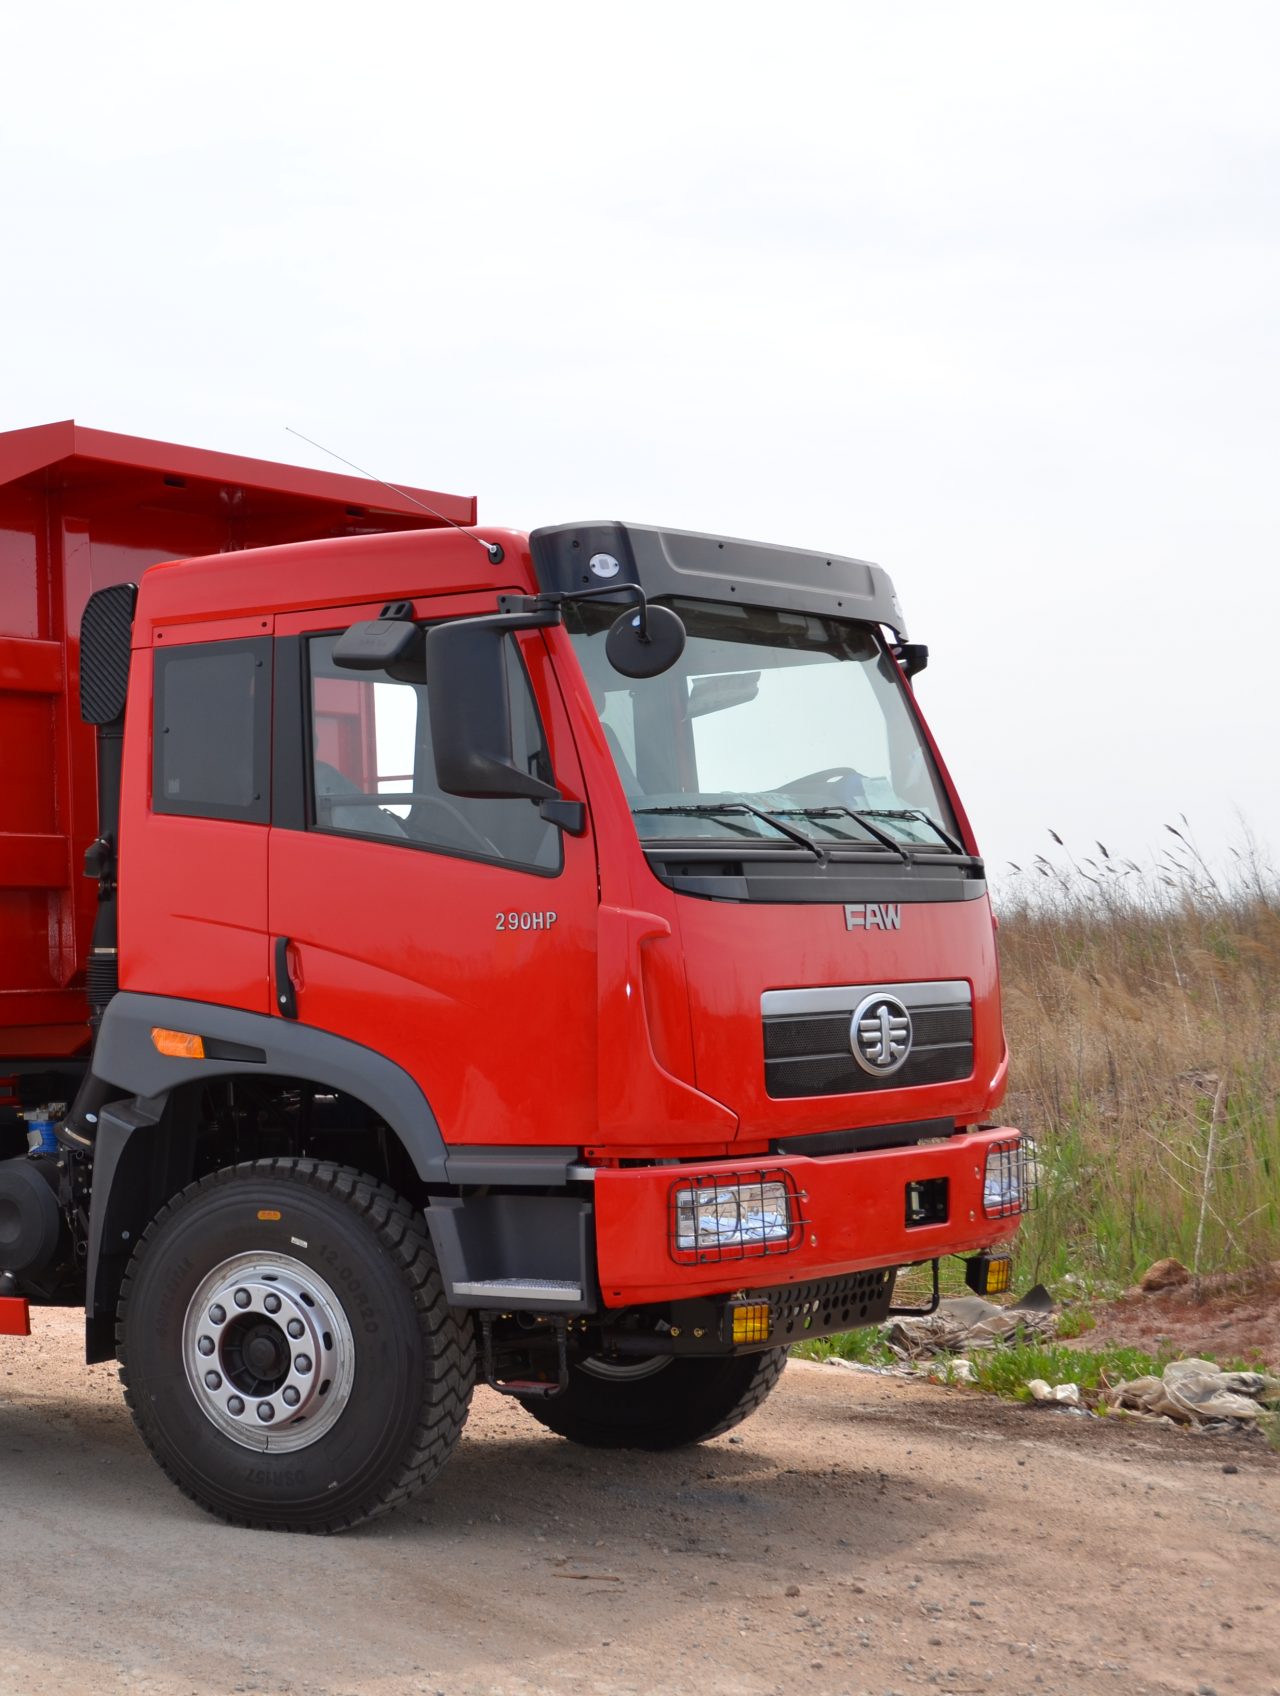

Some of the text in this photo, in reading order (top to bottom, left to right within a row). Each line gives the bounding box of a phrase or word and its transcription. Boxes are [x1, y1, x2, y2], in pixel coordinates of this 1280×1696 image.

[495, 911, 558, 930] 290HP
[844, 903, 901, 931] FAW
[319, 1244, 380, 1334] 12.00R20
[245, 1469, 307, 1487] DSR157
